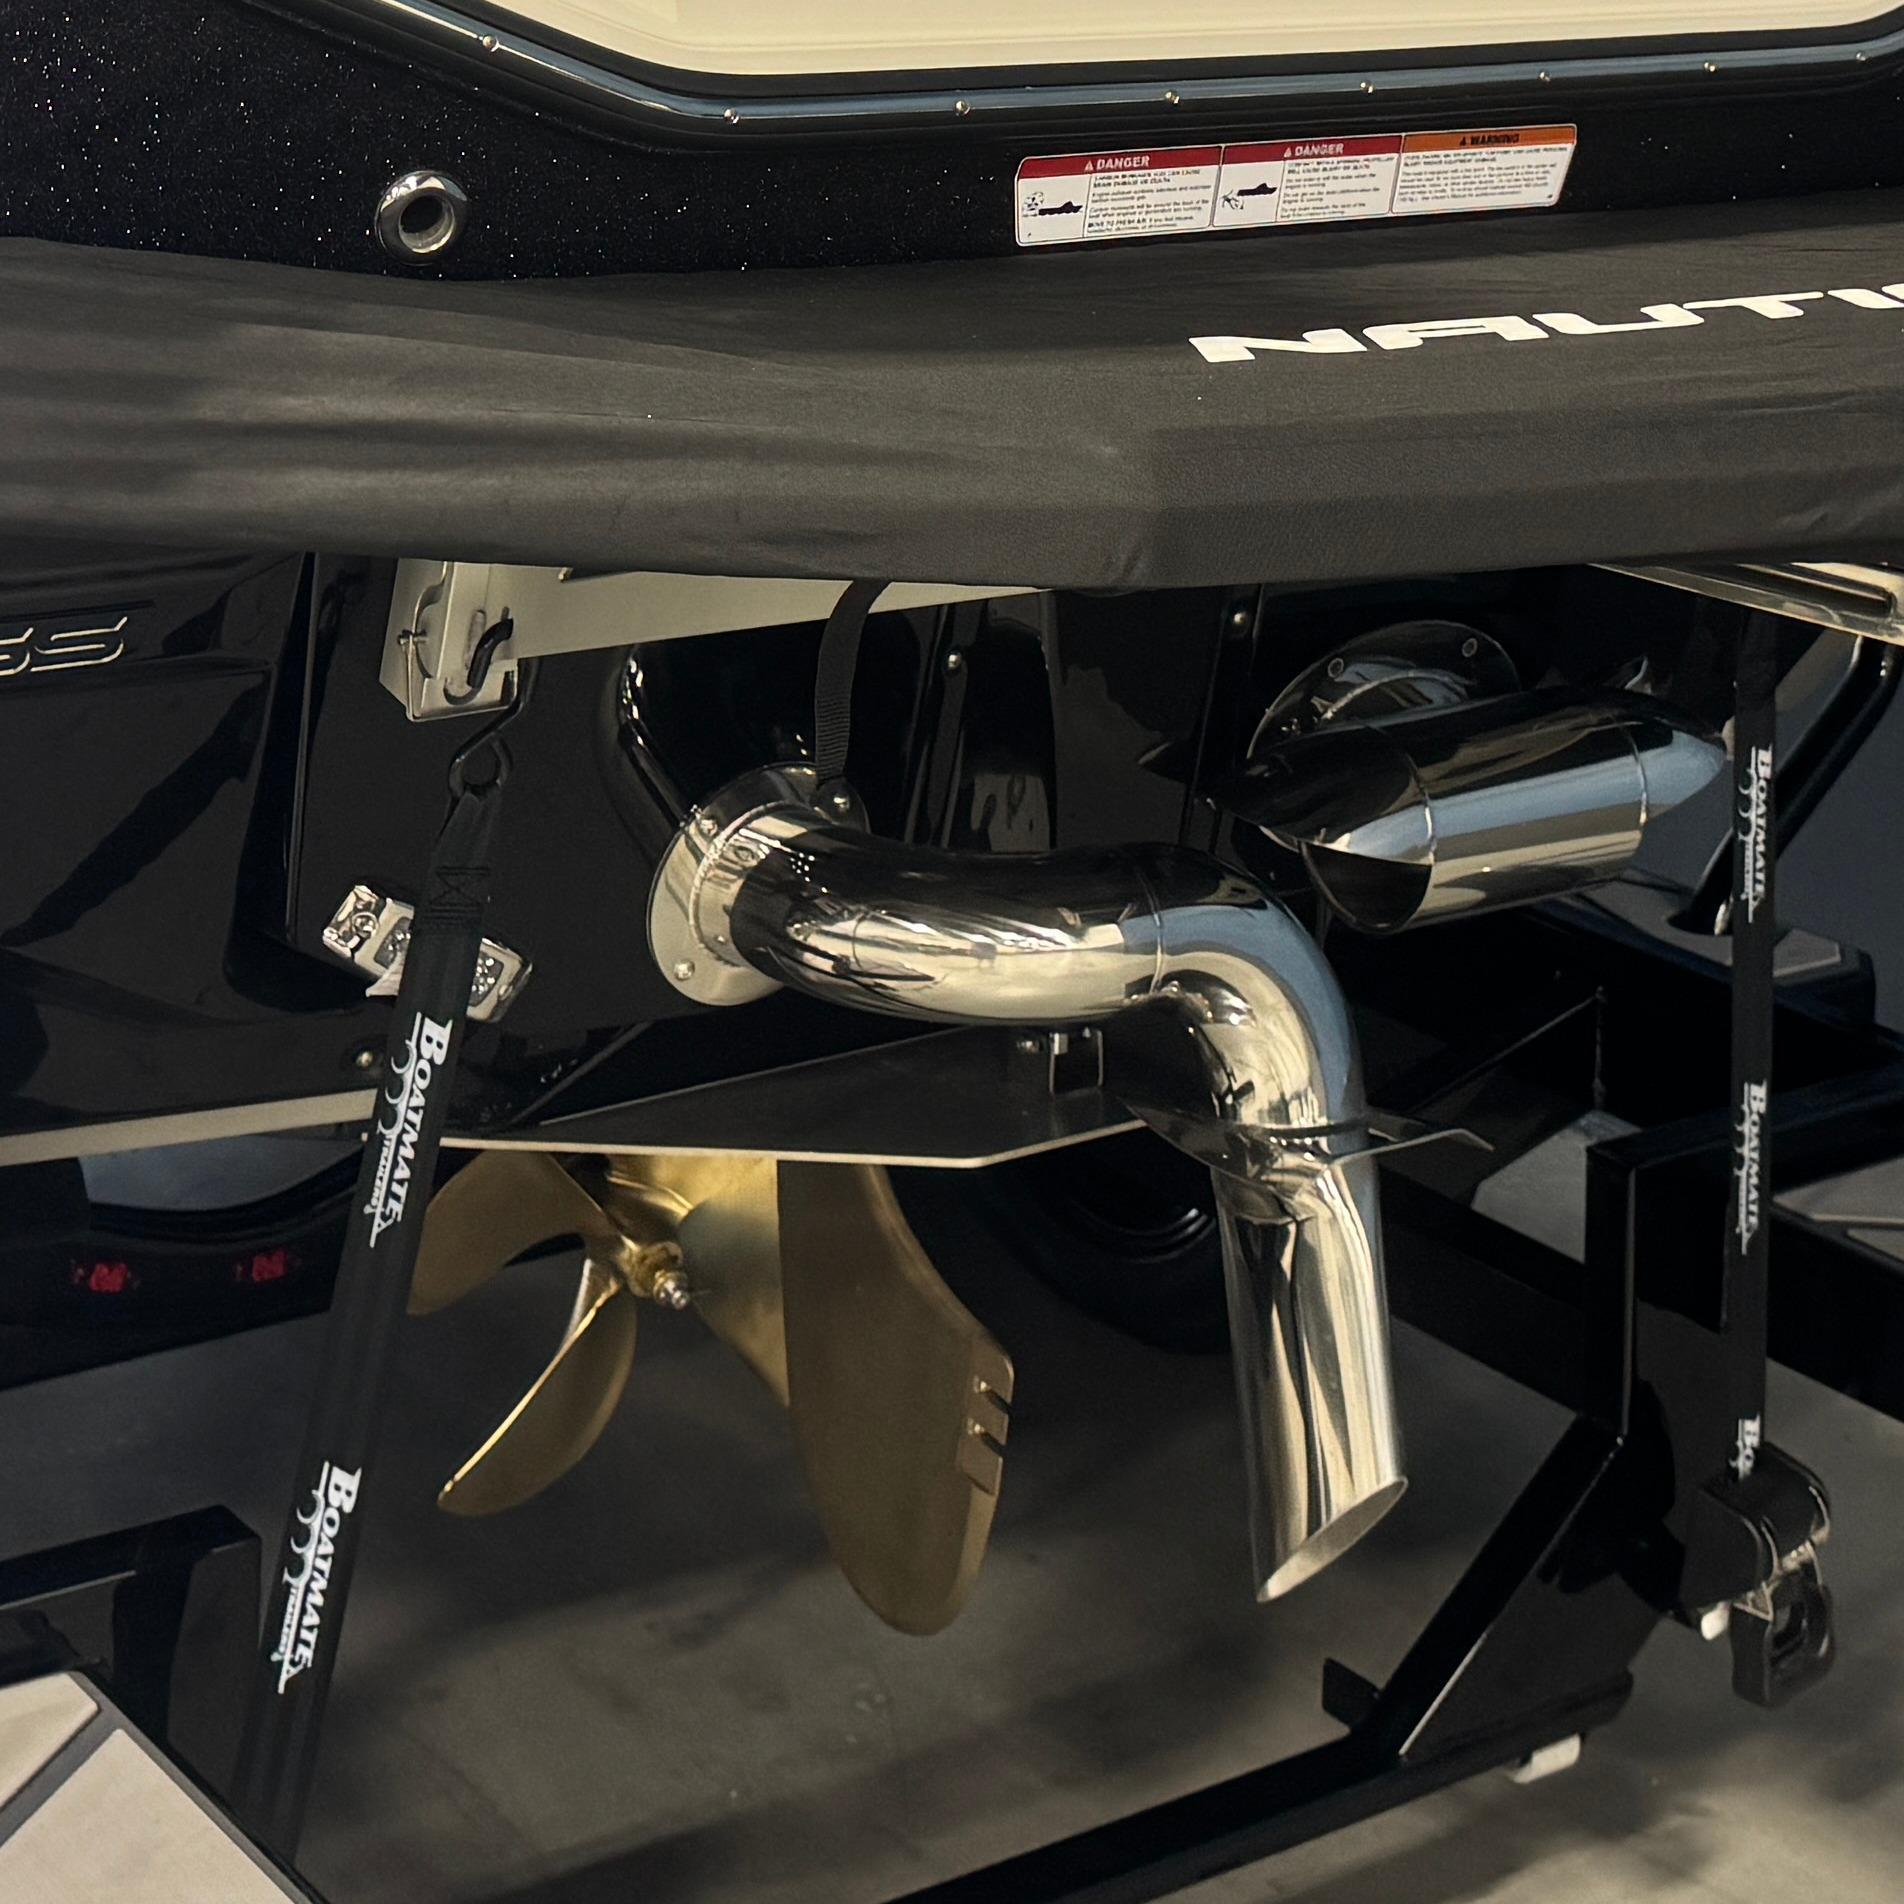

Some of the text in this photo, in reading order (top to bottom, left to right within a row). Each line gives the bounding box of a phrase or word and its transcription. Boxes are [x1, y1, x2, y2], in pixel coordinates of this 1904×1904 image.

[1096, 155, 1151, 171] DANGER
[1294, 142, 1345, 158] DANGER
[384, 1016, 454, 1222] BOATMATE
[294, 1465, 363, 1668] BOATMATE
